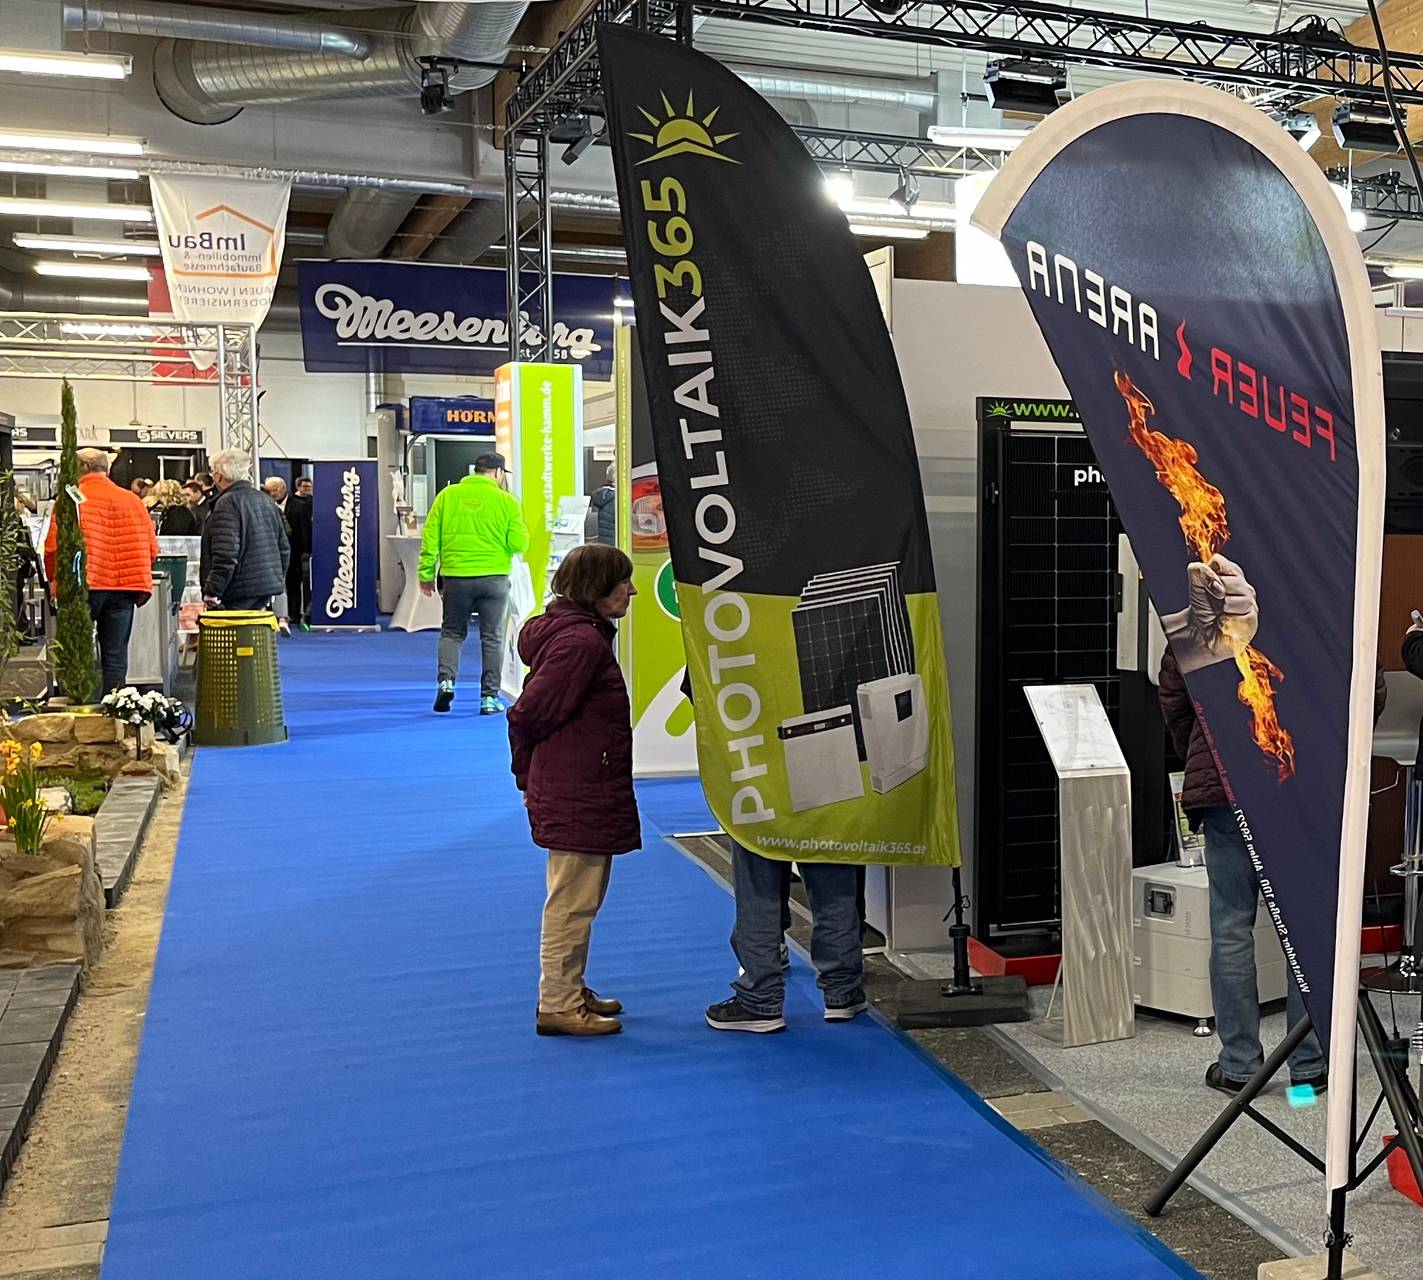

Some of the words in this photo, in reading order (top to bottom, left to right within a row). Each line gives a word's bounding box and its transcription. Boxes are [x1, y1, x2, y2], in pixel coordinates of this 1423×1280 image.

[150, 430, 198, 440] SIEVERS
[641, 175, 777, 827] PHOTOVOLTAIK365
[326, 467, 361, 619] Meesenburg
